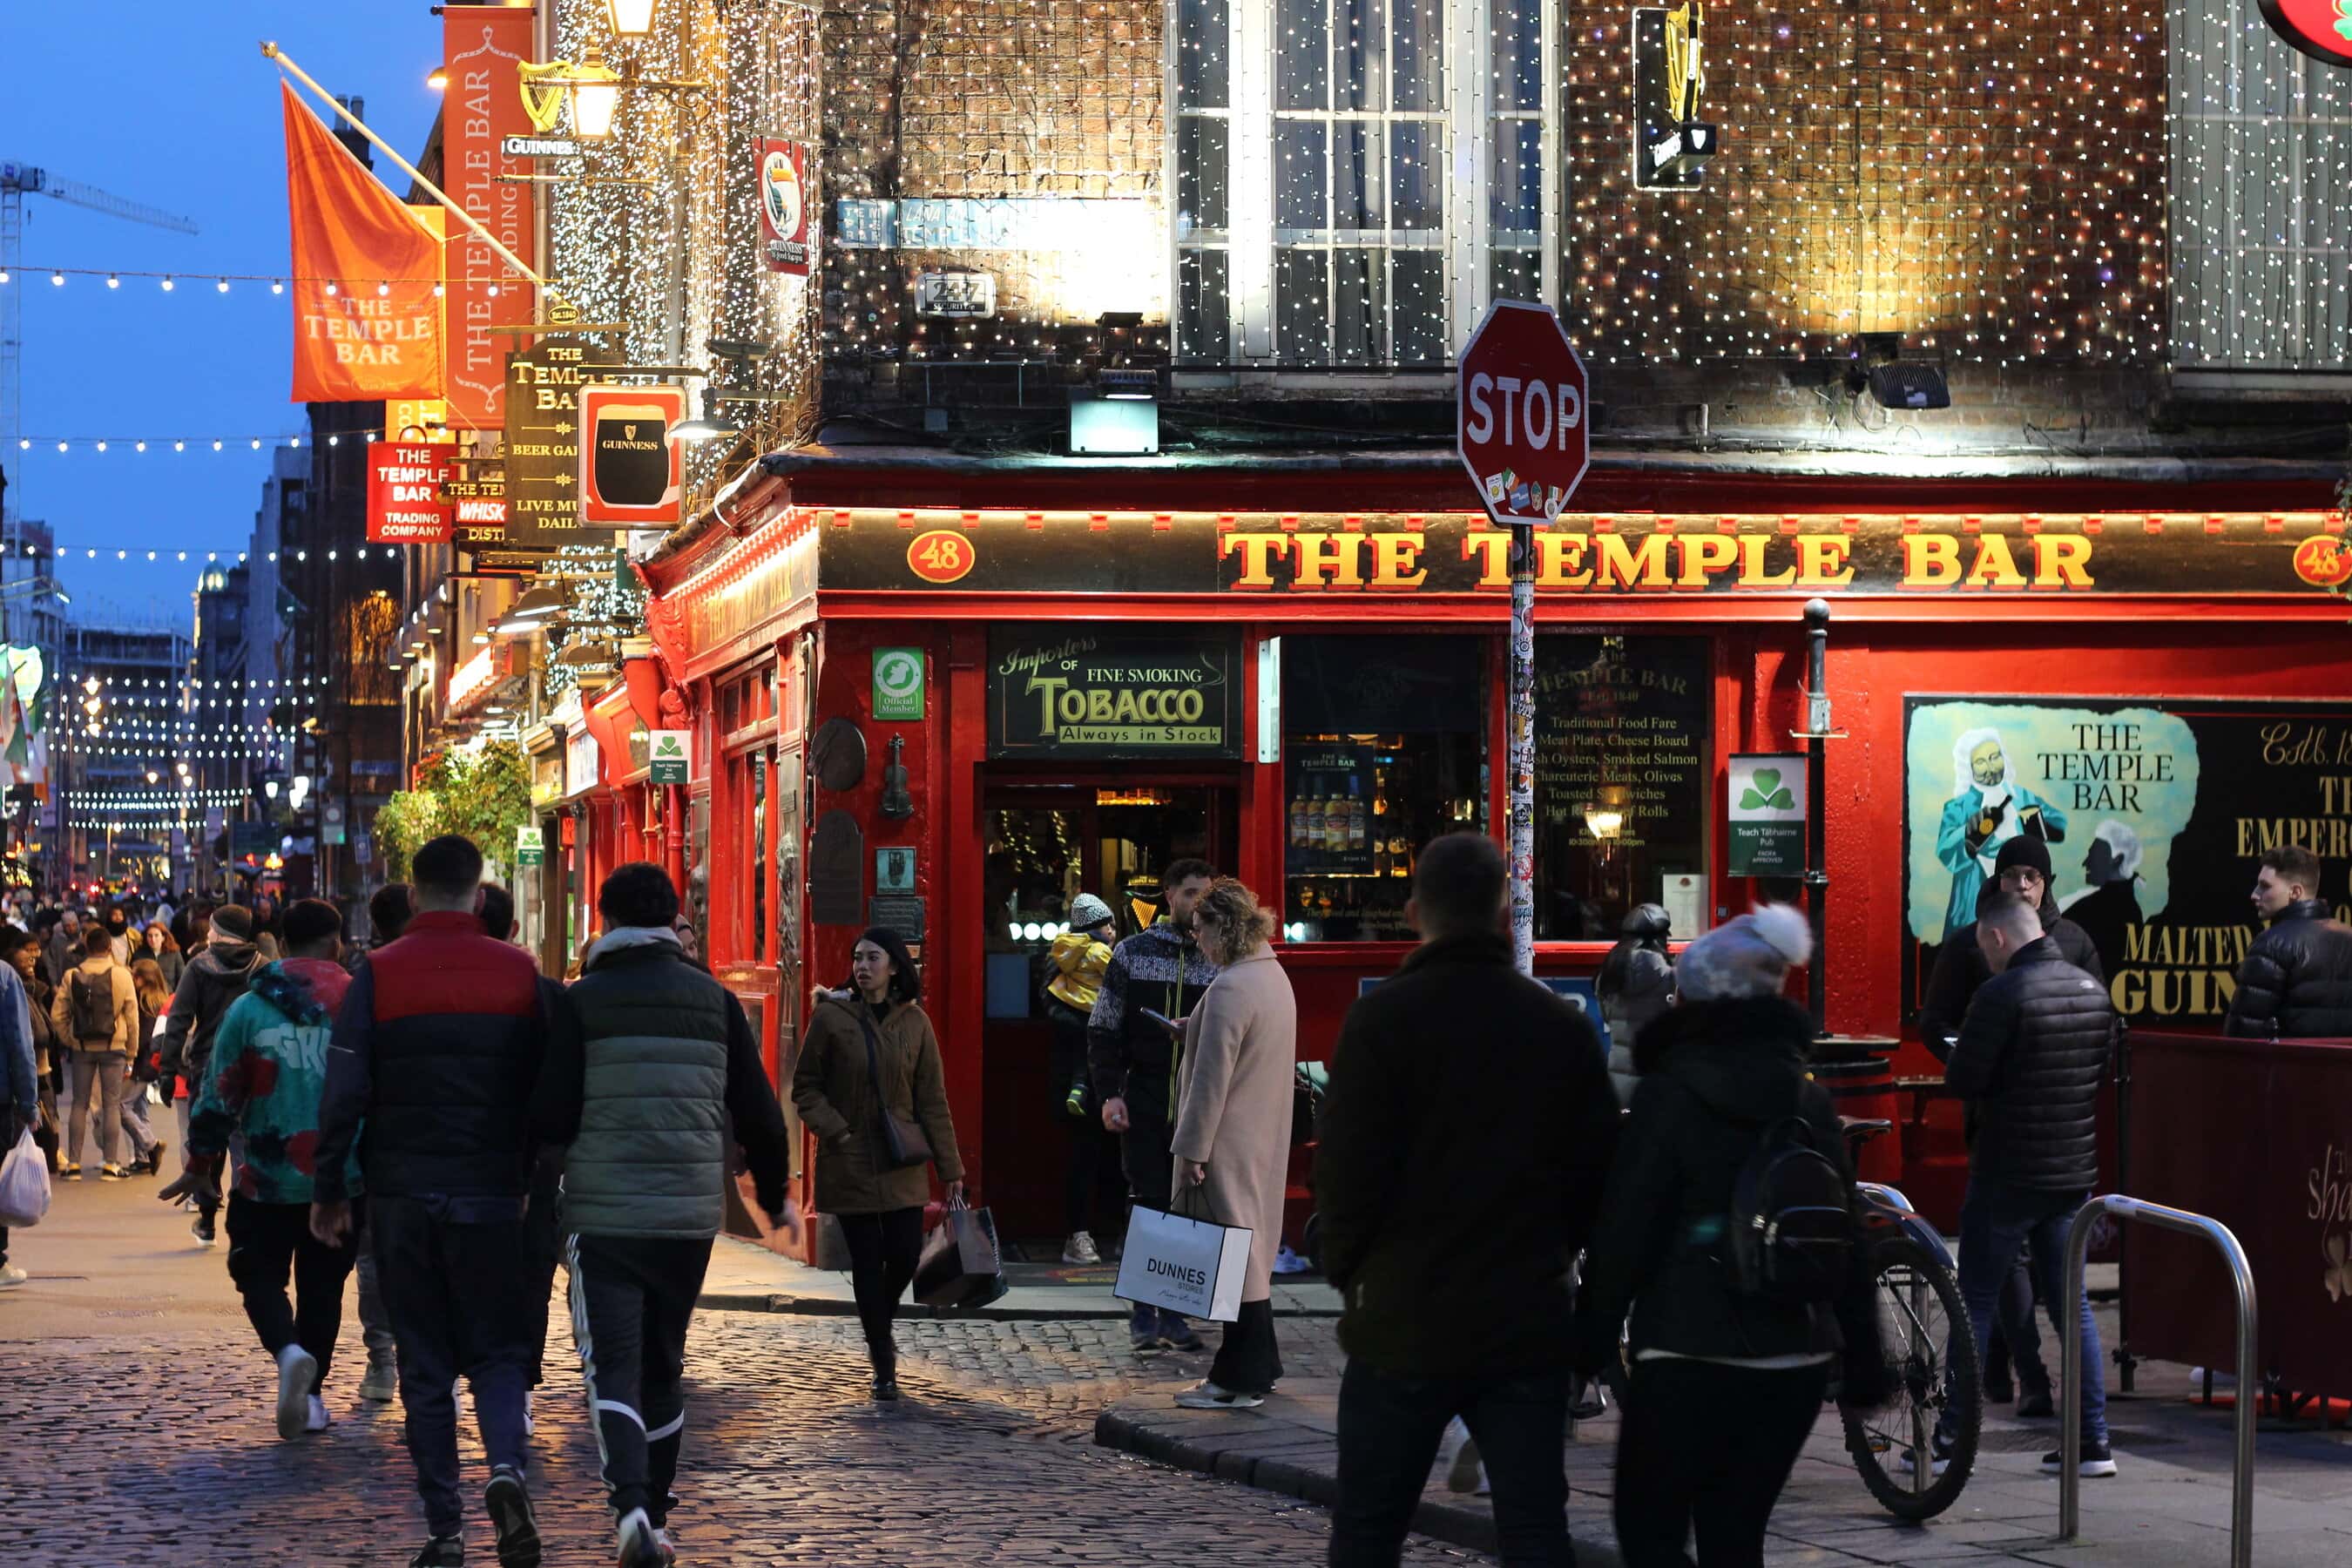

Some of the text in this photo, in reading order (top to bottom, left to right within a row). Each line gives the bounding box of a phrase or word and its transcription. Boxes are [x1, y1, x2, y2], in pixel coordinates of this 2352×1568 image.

[464, 70, 490, 139] BAR
[770, 239, 803, 254] GUINNESS
[341, 298, 391, 315] THE
[303, 314, 434, 341] TEMPLE
[467, 301, 491, 371] THE
[335, 342, 403, 366] BAR
[547, 348, 583, 361] THE
[536, 389, 578, 409] BA
[1467, 372, 1581, 451] STOP
[513, 445, 550, 456] BEER
[553, 445, 578, 456] GA
[603, 440, 659, 451] GUINNESS
[395, 449, 431, 463] THE
[393, 486, 432, 502] BAR
[448, 483, 477, 496] THE
[458, 502, 505, 521] WHISK
[517, 500, 578, 511] LIVE MU
[386, 512, 440, 524] TRADING
[538, 517, 578, 529] DAIL
[382, 525, 443, 537] COMPANY
[919, 537, 961, 572] 48
[1220, 532, 2095, 592] THE TEMPLE BAR
[2294, 544, 2331, 575] 48
[998, 637, 1098, 676] Importers
[1061, 660, 1203, 683] OF FINE SMOKING
[1540, 668, 1688, 695] TEMPLE BAR
[1024, 677, 1205, 737] TOBACCO
[1552, 717, 1678, 729] Traditional Food Fare
[1062, 727, 1218, 742] Always in Stock
[1540, 734, 1568, 747] Meat
[1608, 734, 1650, 747] Cheese
[1654, 734, 1688, 747] Board
[2072, 724, 2142, 752] THE
[1603, 753, 1651, 765] Smoked
[1653, 753, 1698, 765] Salmon
[2037, 753, 2173, 781] TEMPLE
[1645, 770, 1683, 782] Olives
[1549, 787, 1593, 800] Toasted
[1597, 787, 1666, 800] Swiches
[2072, 782, 2143, 814] BAR
[1546, 805, 1568, 817] Hot
[1639, 805, 1669, 817] Rolls
[1737, 828, 1759, 836] Teach
[2236, 817, 2352, 858] EMPER
[1760, 837, 1774, 846] Pub
[2123, 922, 2254, 966] MALTED
[2111, 968, 2239, 1016] GUIN
[1146, 1258, 1206, 1286] DUNNES
[1178, 1282, 1204, 1295] STORES
